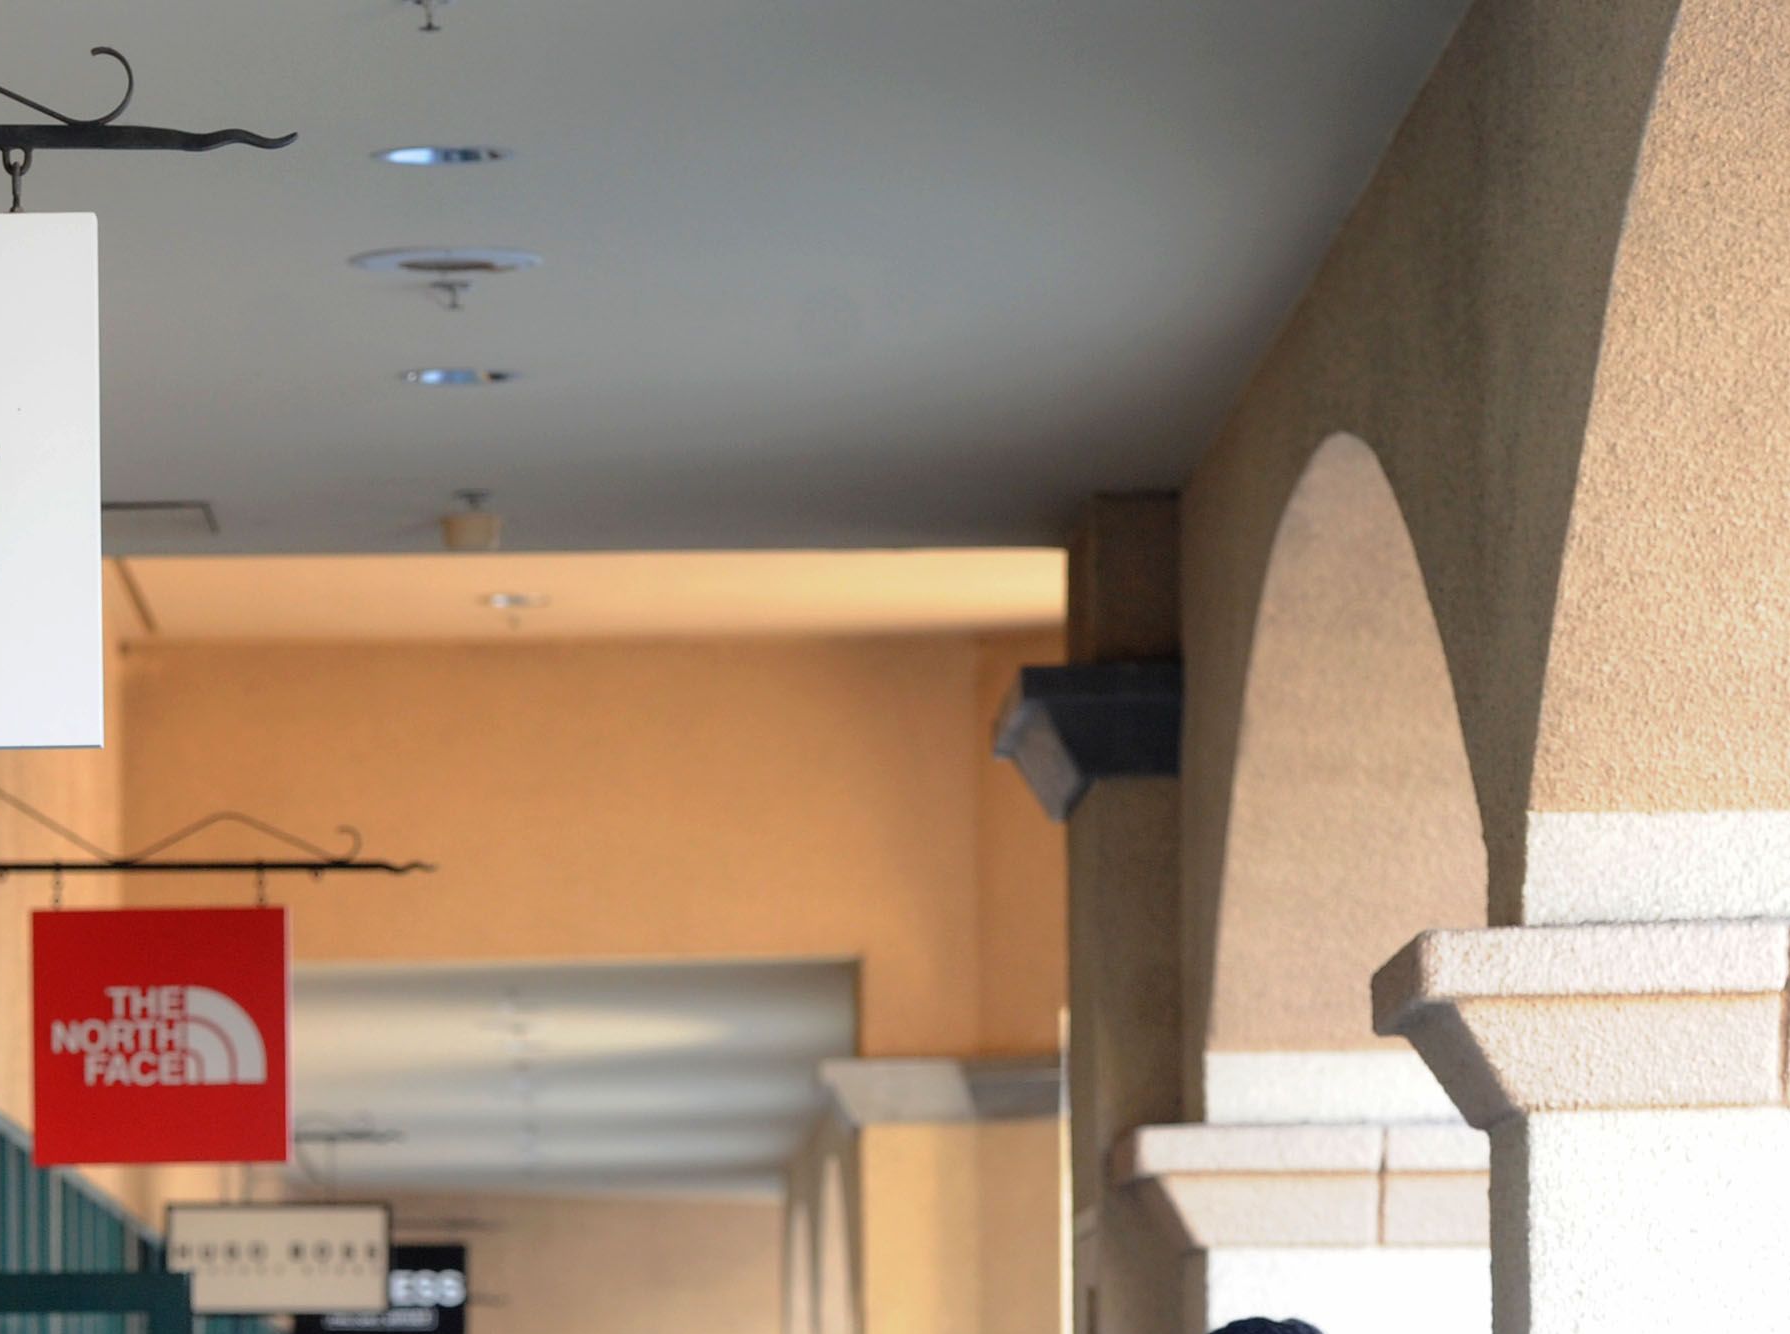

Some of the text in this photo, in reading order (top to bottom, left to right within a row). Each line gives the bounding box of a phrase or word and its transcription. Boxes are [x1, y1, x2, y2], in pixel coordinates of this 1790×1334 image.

[104, 985, 183, 1018] THE
[51, 1019, 184, 1053] NORTH
[83, 1053, 184, 1086] FACE
